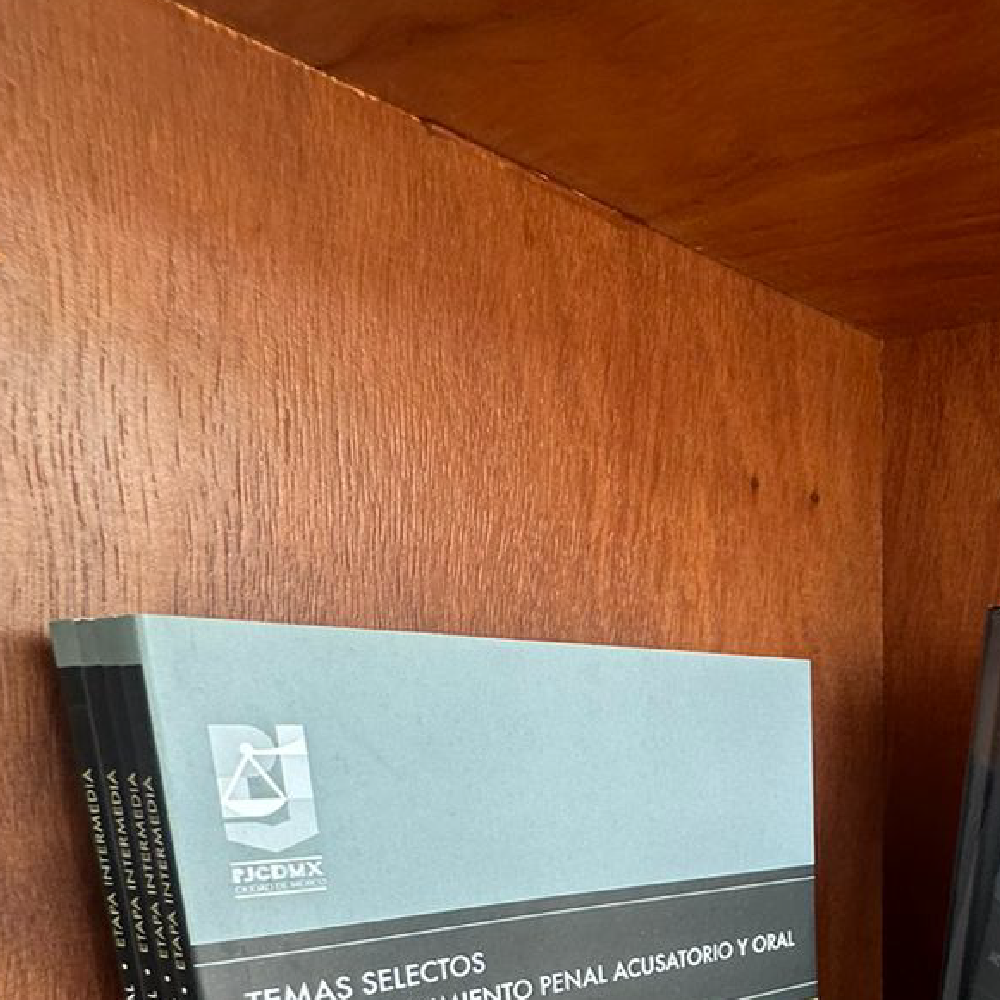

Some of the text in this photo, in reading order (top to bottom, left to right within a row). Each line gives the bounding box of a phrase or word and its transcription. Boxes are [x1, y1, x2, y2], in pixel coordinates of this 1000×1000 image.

[231, 861, 323, 884] PJCDMX
[361, 951, 487, 996] SELECTOS
[540, 964, 609, 996] PENAL
[612, 940, 734, 982] ACUSATORIO
[736, 937, 749, 956] Y
[751, 929, 796, 954] ORAL
